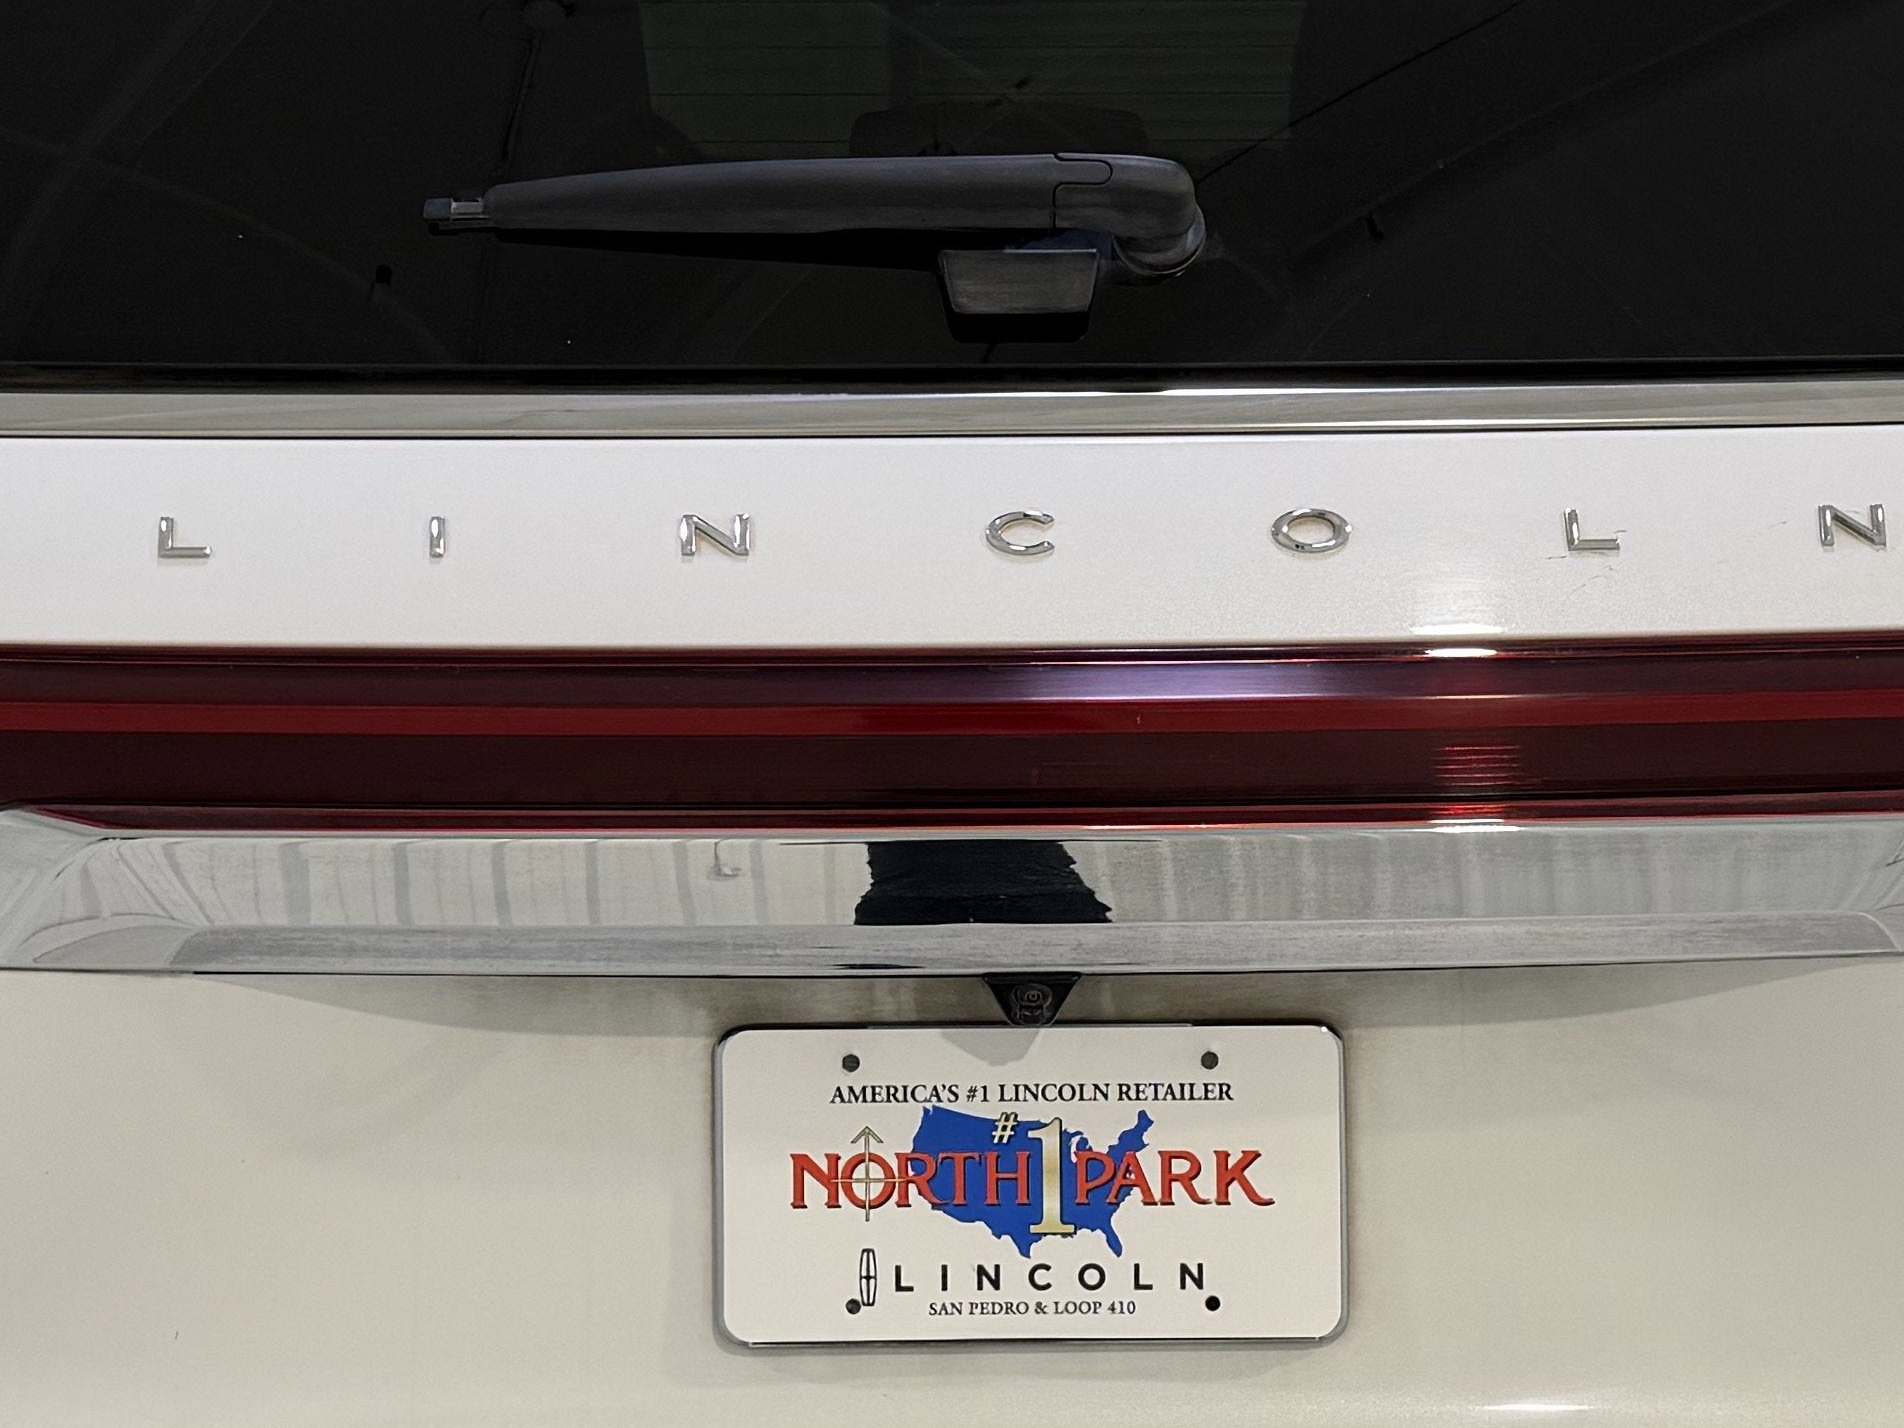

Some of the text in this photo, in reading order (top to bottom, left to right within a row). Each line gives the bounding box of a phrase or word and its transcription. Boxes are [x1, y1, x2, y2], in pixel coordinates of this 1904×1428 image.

[157, 505, 1887, 562] LINCOLN
[829, 1081, 1235, 1105] AMERICA'S #1 LINCOLN RETAILER
[790, 1149, 1276, 1210] NORTH PARK
[894, 1262, 1205, 1293] LINCOLN
[928, 1300, 1137, 1316] SAN PEDRO & LOOP 410
